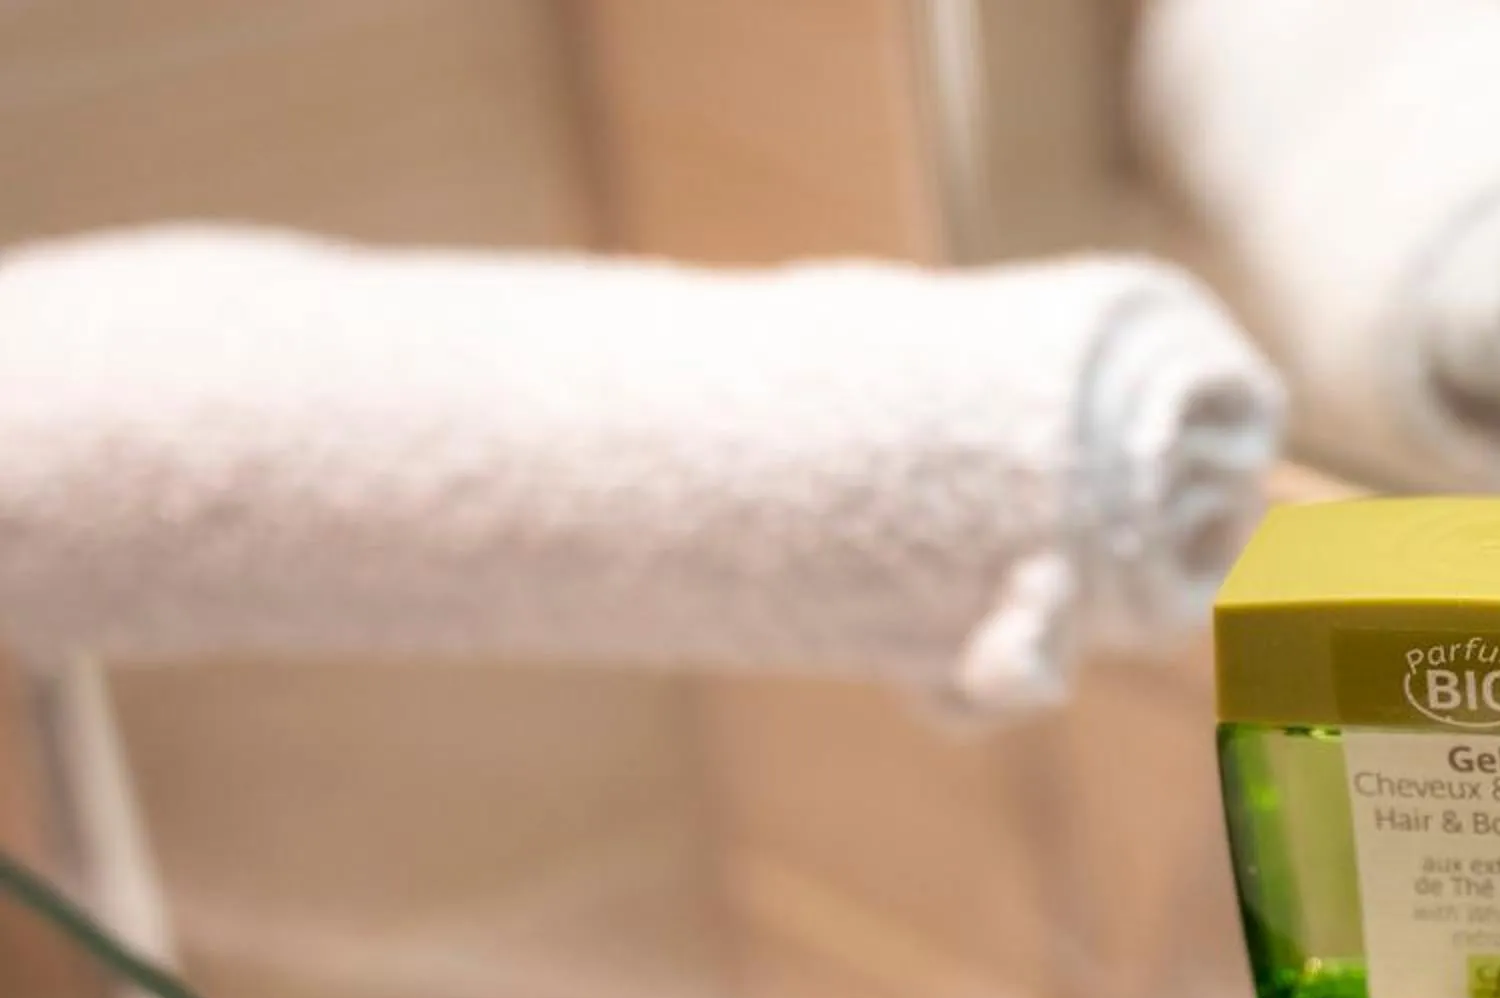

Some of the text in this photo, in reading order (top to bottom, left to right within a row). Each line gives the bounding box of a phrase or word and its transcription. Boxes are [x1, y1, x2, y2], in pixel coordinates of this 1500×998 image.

[1353, 772, 1482, 799] Cheveux
[1375, 807, 1433, 833] Hair
[1441, 810, 1465, 834] &
[1422, 856, 1461, 873] aux
[1414, 876, 1443, 896] de
